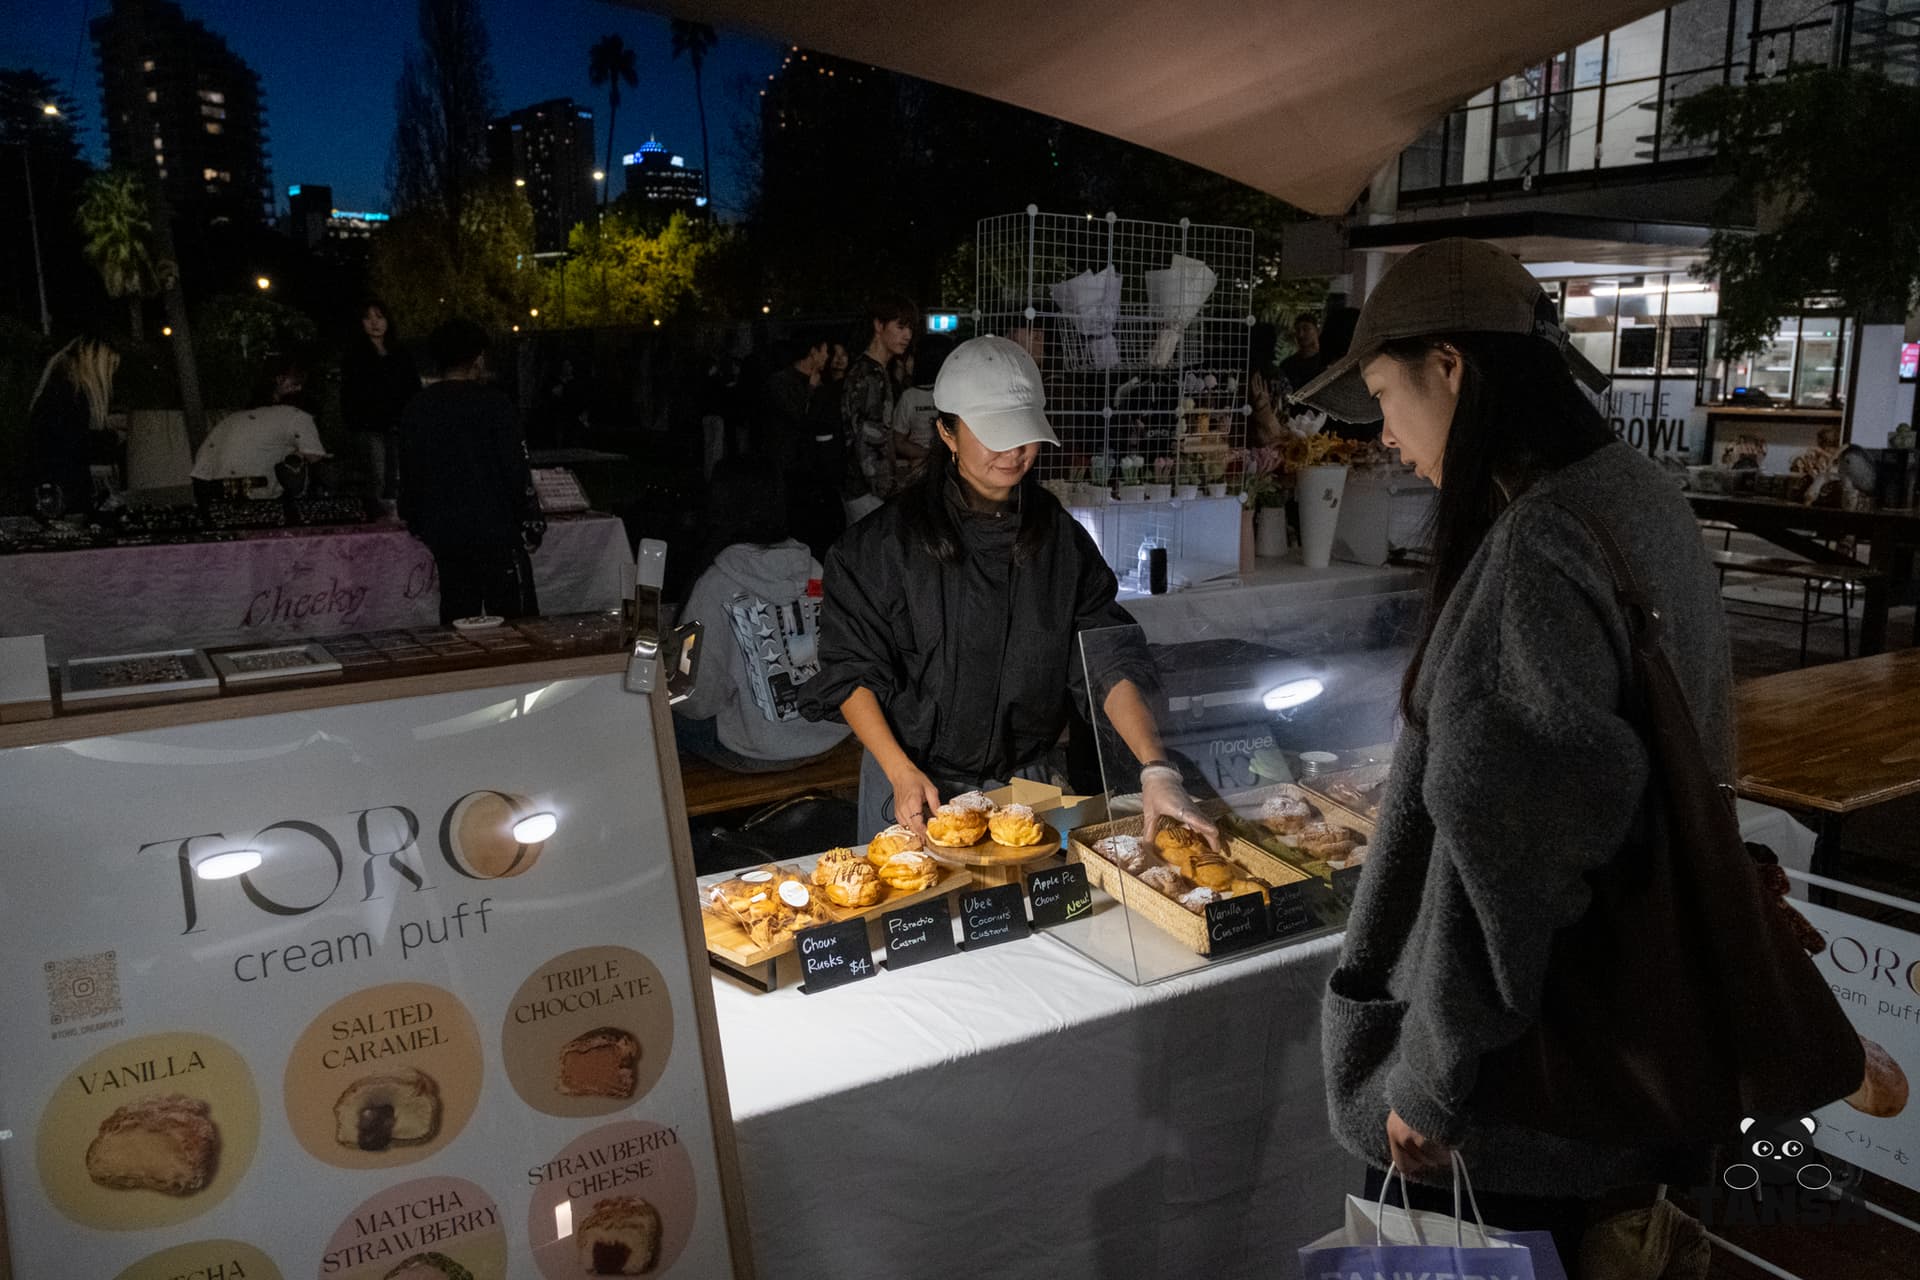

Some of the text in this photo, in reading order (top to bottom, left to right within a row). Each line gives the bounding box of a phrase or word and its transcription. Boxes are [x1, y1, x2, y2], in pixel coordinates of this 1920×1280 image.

[1630, 392, 1671, 417] THE
[243, 577, 368, 626] Cheeky
[138, 790, 530, 936] TORO
[1033, 876, 1060, 893] Apple
[1066, 891, 1091, 917] New!
[1208, 903, 1241, 922] Vanilla
[1212, 916, 1252, 941] Custard
[234, 898, 494, 983] cream puff
[802, 936, 838, 954] Choux
[542, 959, 621, 993] TRIPLE
[807, 953, 870, 976] Rusks $4
[1816, 928, 1920, 995] OR
[514, 976, 653, 1024] CHOCOLATE
[1831, 984, 1868, 1007] eam
[331, 1002, 433, 1041] SALTED
[321, 1026, 449, 1070] CARAMEL
[78, 1050, 207, 1095] VANILLA
[527, 1125, 681, 1186] STRAWBERRY
[566, 1159, 655, 1199] CHEESE
[354, 1190, 464, 1238] MATCHA
[322, 1204, 499, 1274] STRAWBERRY
